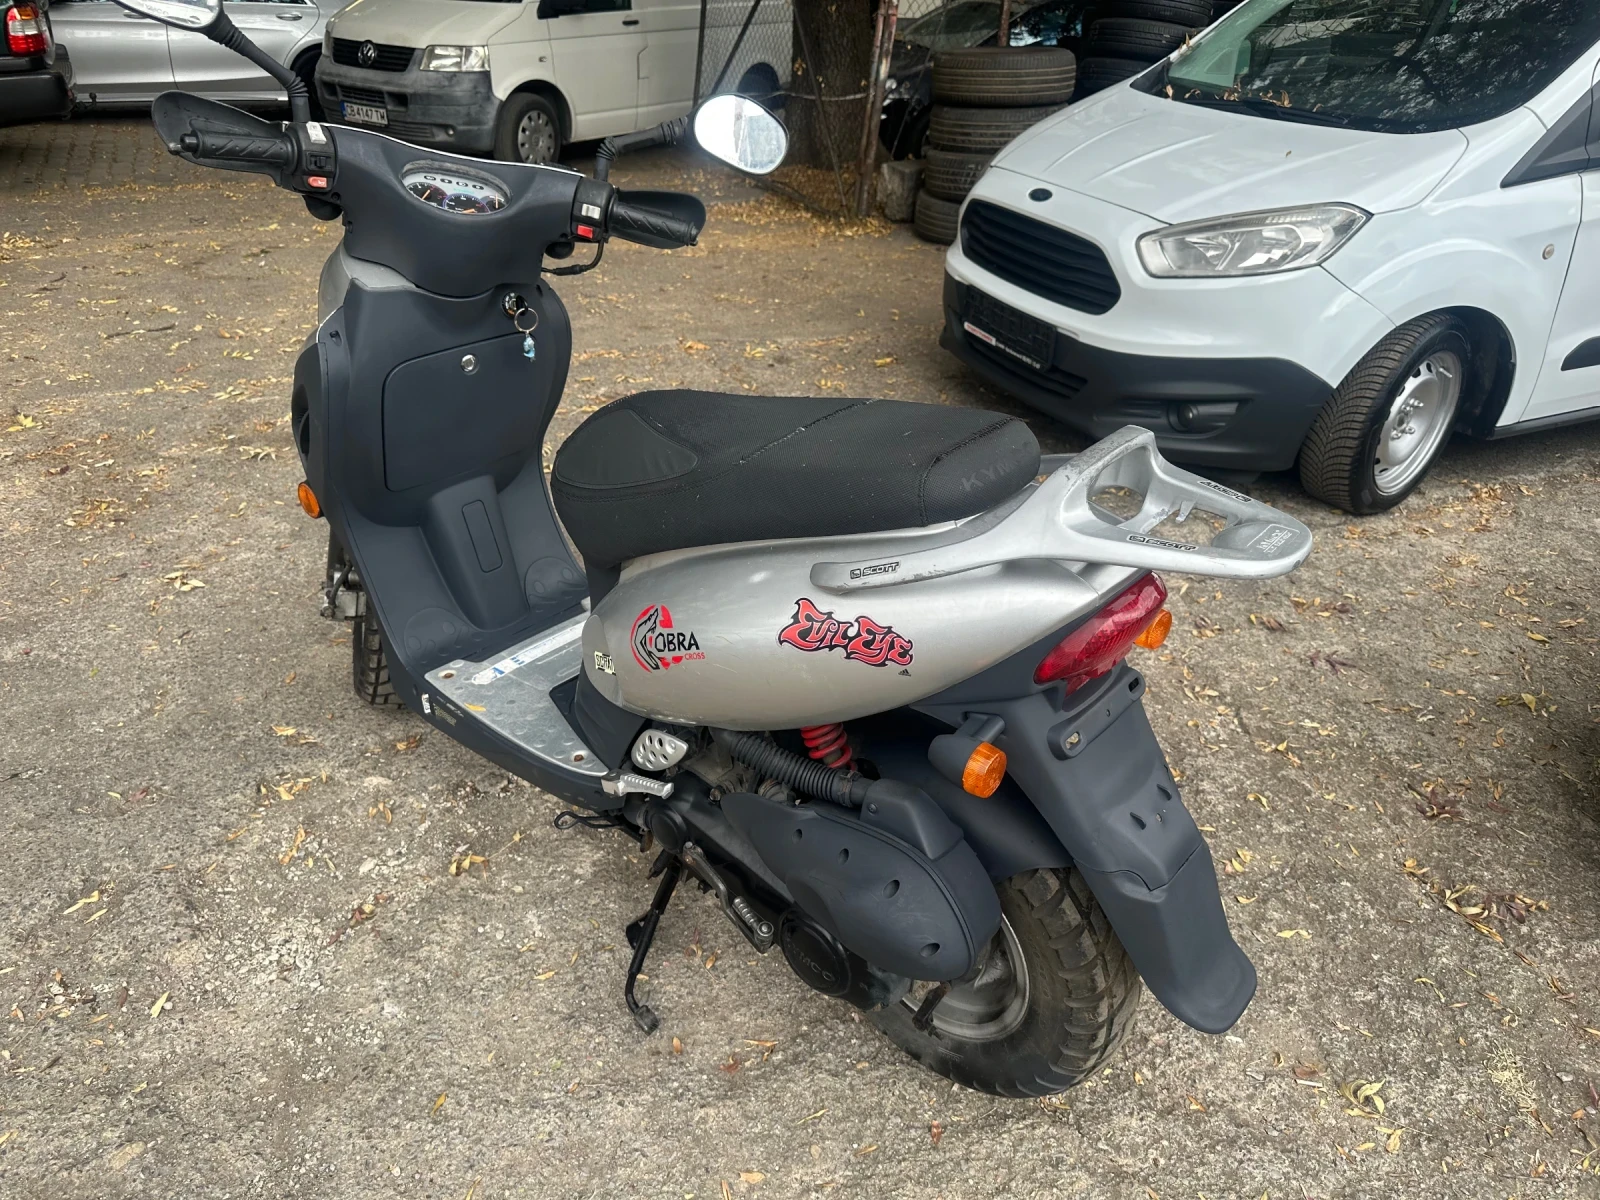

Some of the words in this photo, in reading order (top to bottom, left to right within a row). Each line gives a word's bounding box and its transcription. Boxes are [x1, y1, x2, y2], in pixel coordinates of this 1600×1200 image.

[357, 106, 373, 120] 4147
[862, 561, 900, 577] SCOTT
[684, 652, 706, 661] CROSS
